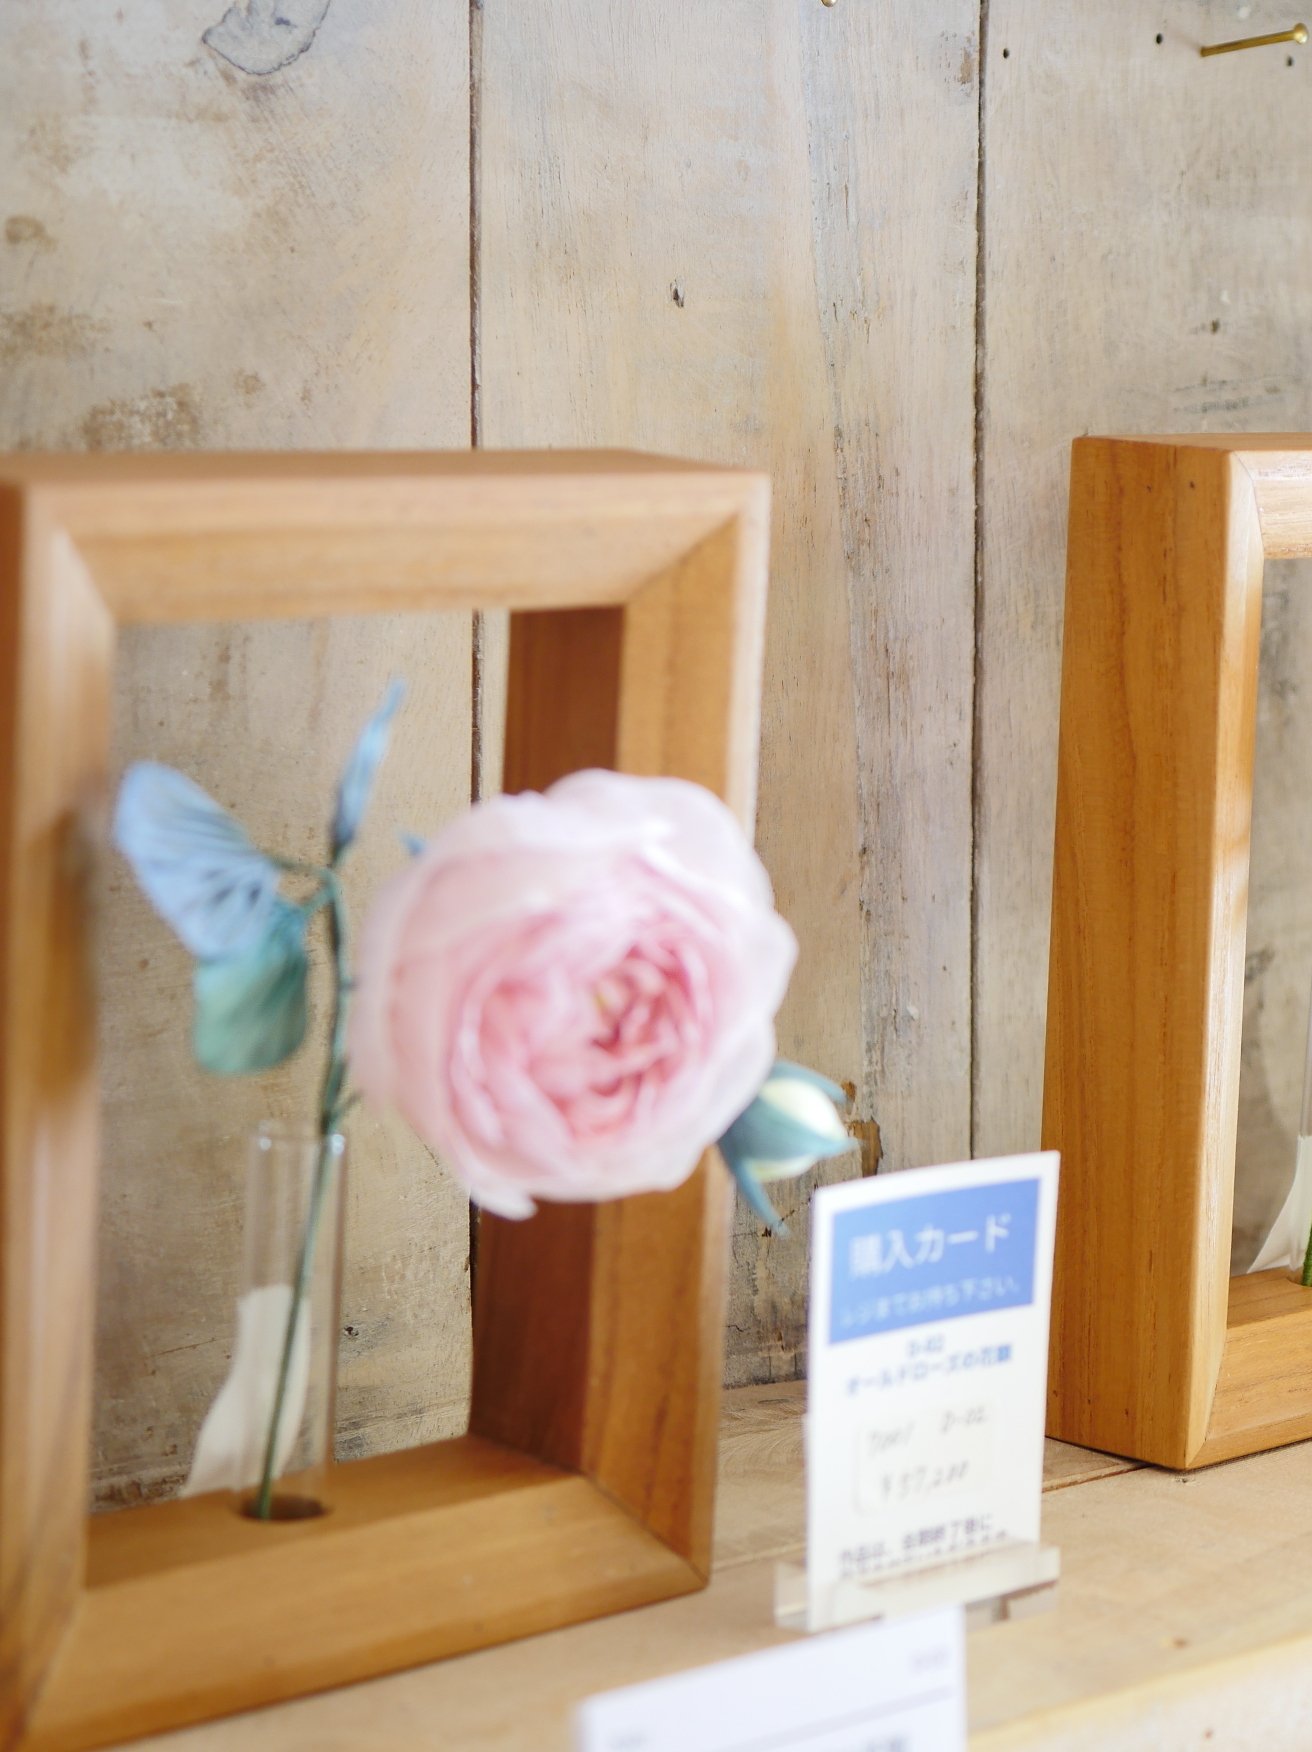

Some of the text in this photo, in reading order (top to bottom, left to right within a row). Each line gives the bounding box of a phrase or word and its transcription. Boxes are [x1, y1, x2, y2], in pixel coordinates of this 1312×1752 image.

[848, 1213, 1012, 1280] 購入カード
